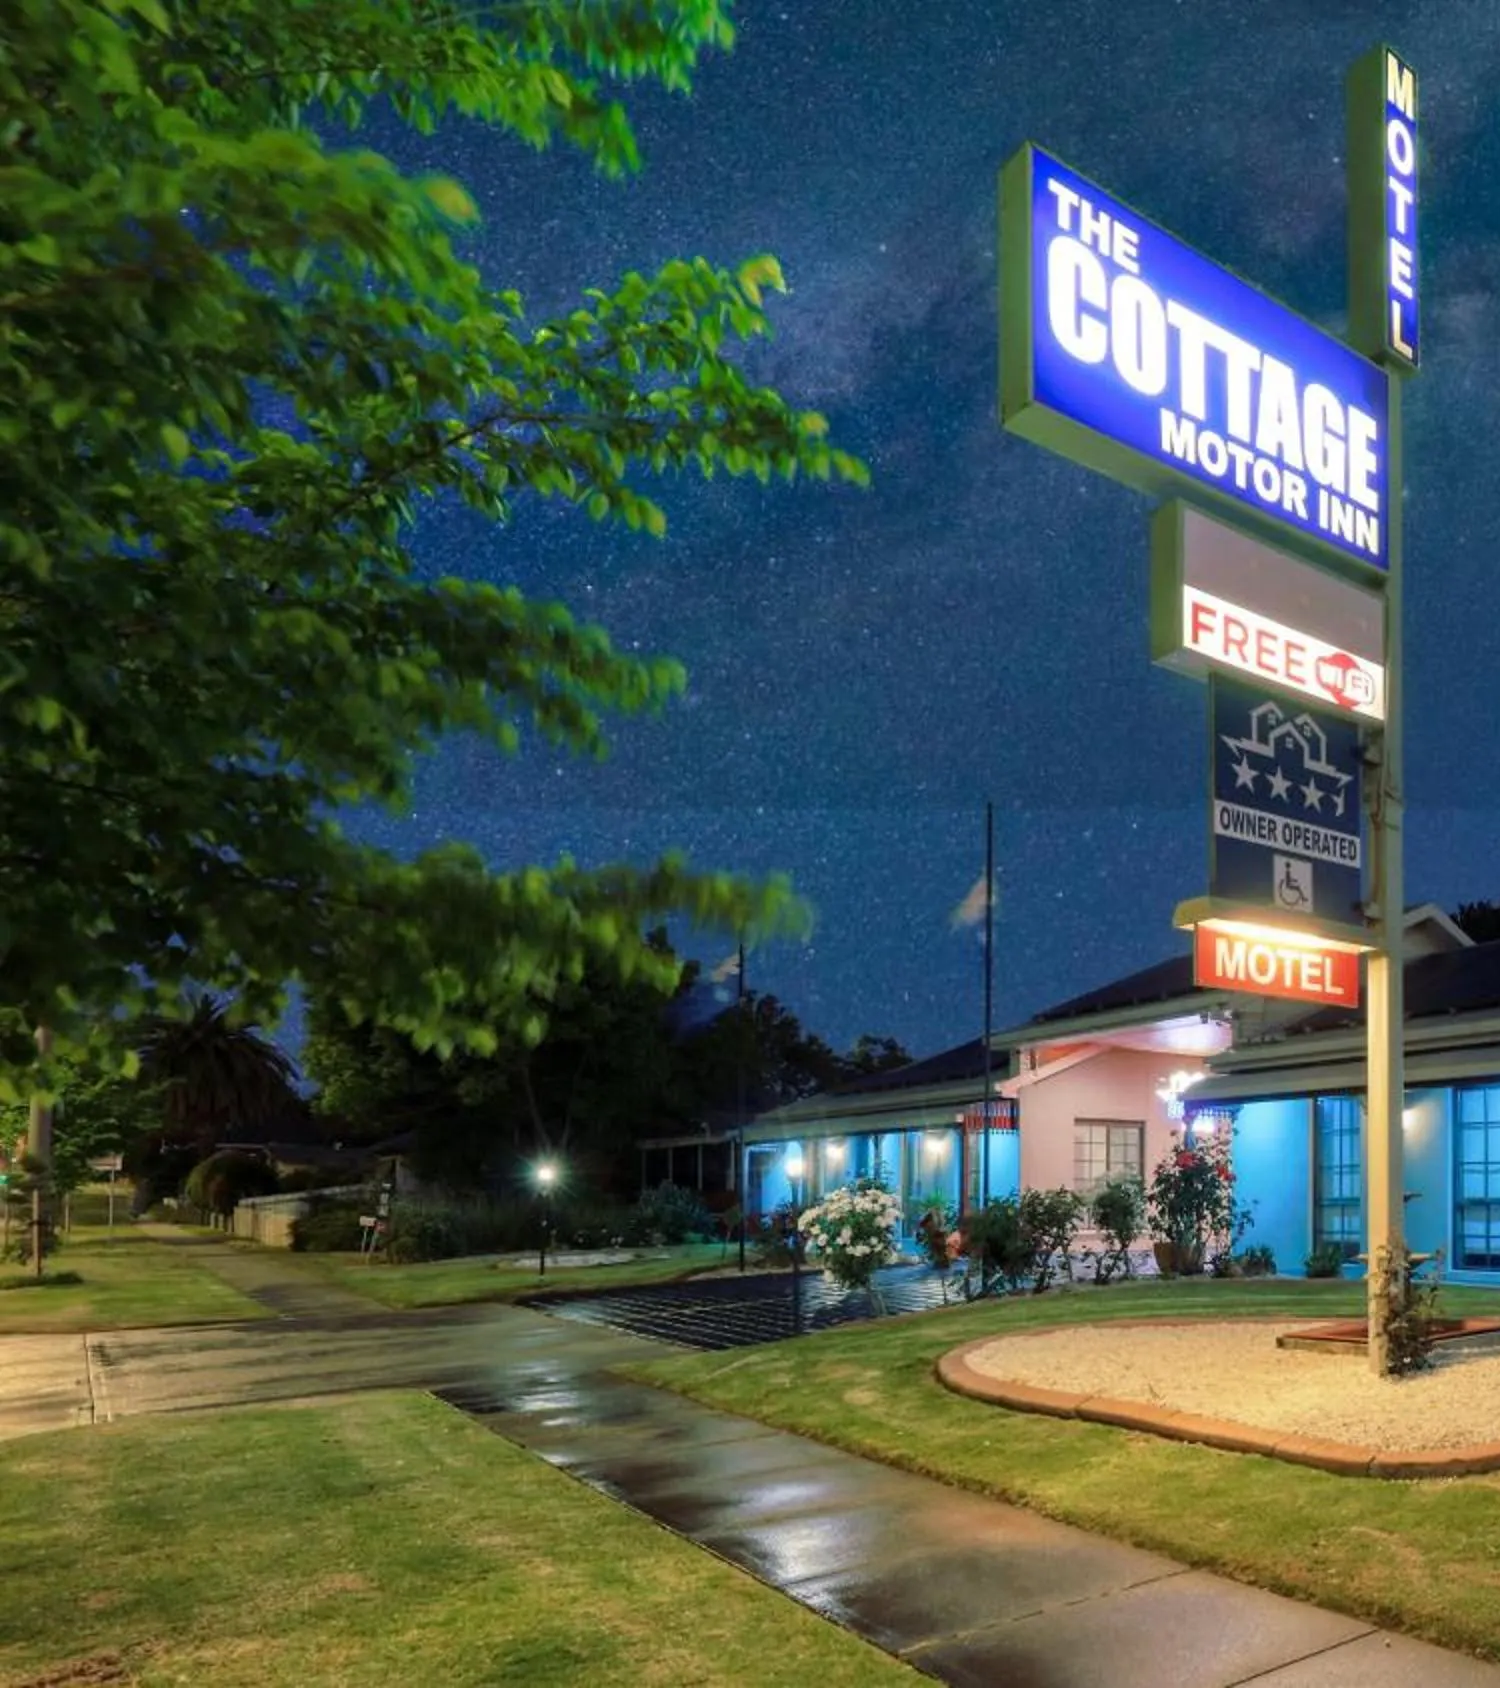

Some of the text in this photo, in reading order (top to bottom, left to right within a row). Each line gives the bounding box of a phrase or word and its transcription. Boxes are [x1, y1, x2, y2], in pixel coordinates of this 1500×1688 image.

[1047, 177, 1140, 273] THE
[1387, 51, 1414, 360] MOTEL
[1047, 236, 1379, 512] COTTAGE
[1160, 408, 1380, 556] MOTOR INN
[1191, 601, 1306, 686] FREE
[1219, 808, 1357, 861] OWNER OPERATED
[1215, 937, 1344, 995] MOTEL
